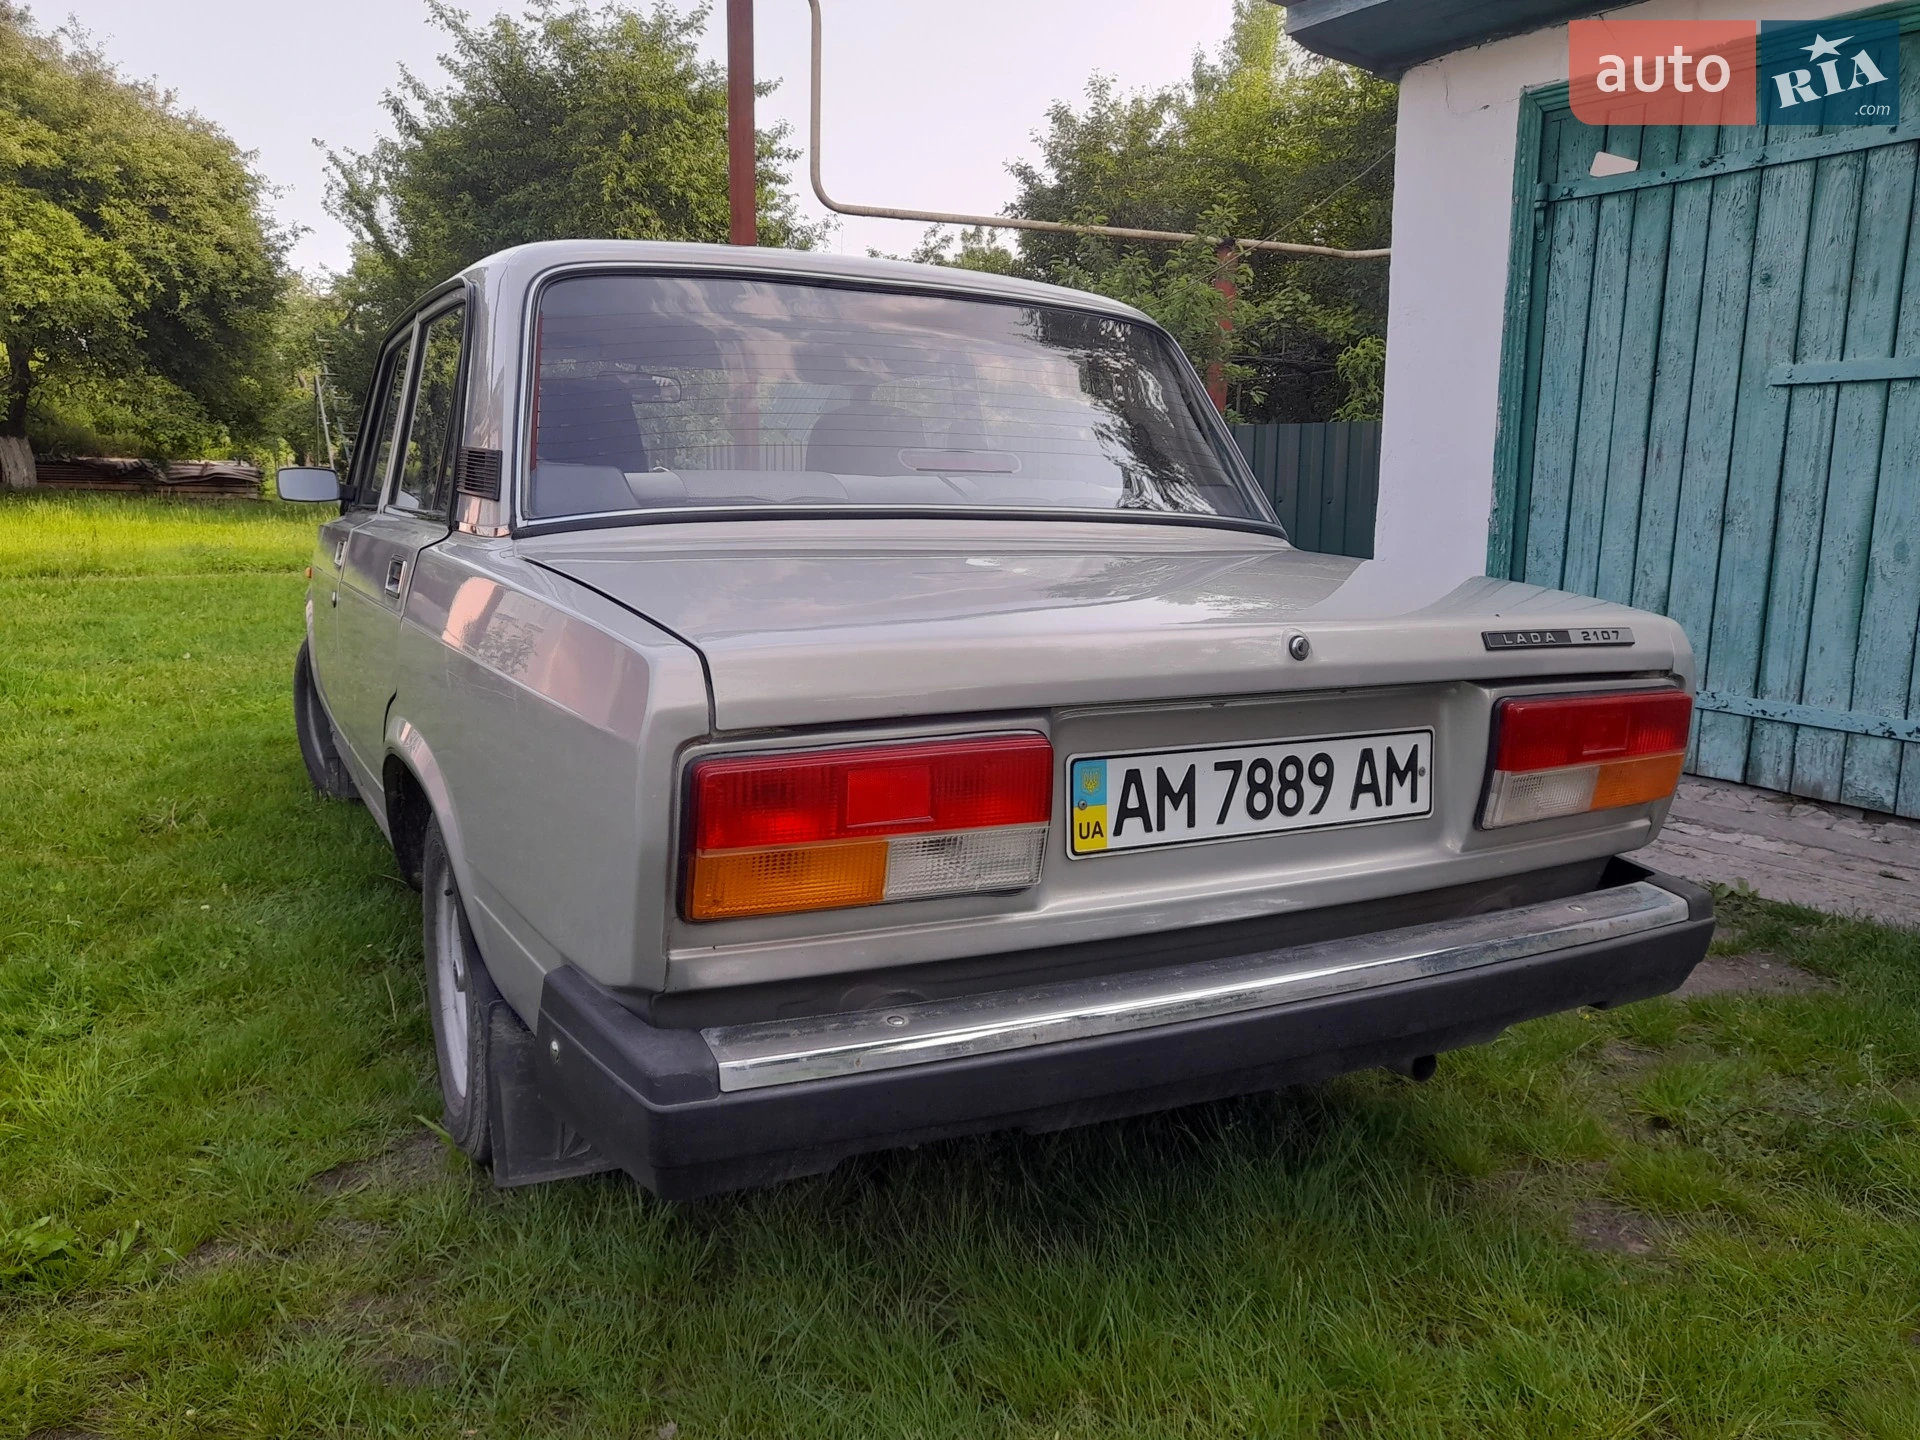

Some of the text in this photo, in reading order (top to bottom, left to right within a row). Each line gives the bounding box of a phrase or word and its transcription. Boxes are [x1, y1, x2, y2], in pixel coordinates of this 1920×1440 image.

[1502, 630, 1620, 644] LADA 2107
[1113, 743, 1419, 837] AM 7889 AM
[1078, 820, 1105, 840] UA
